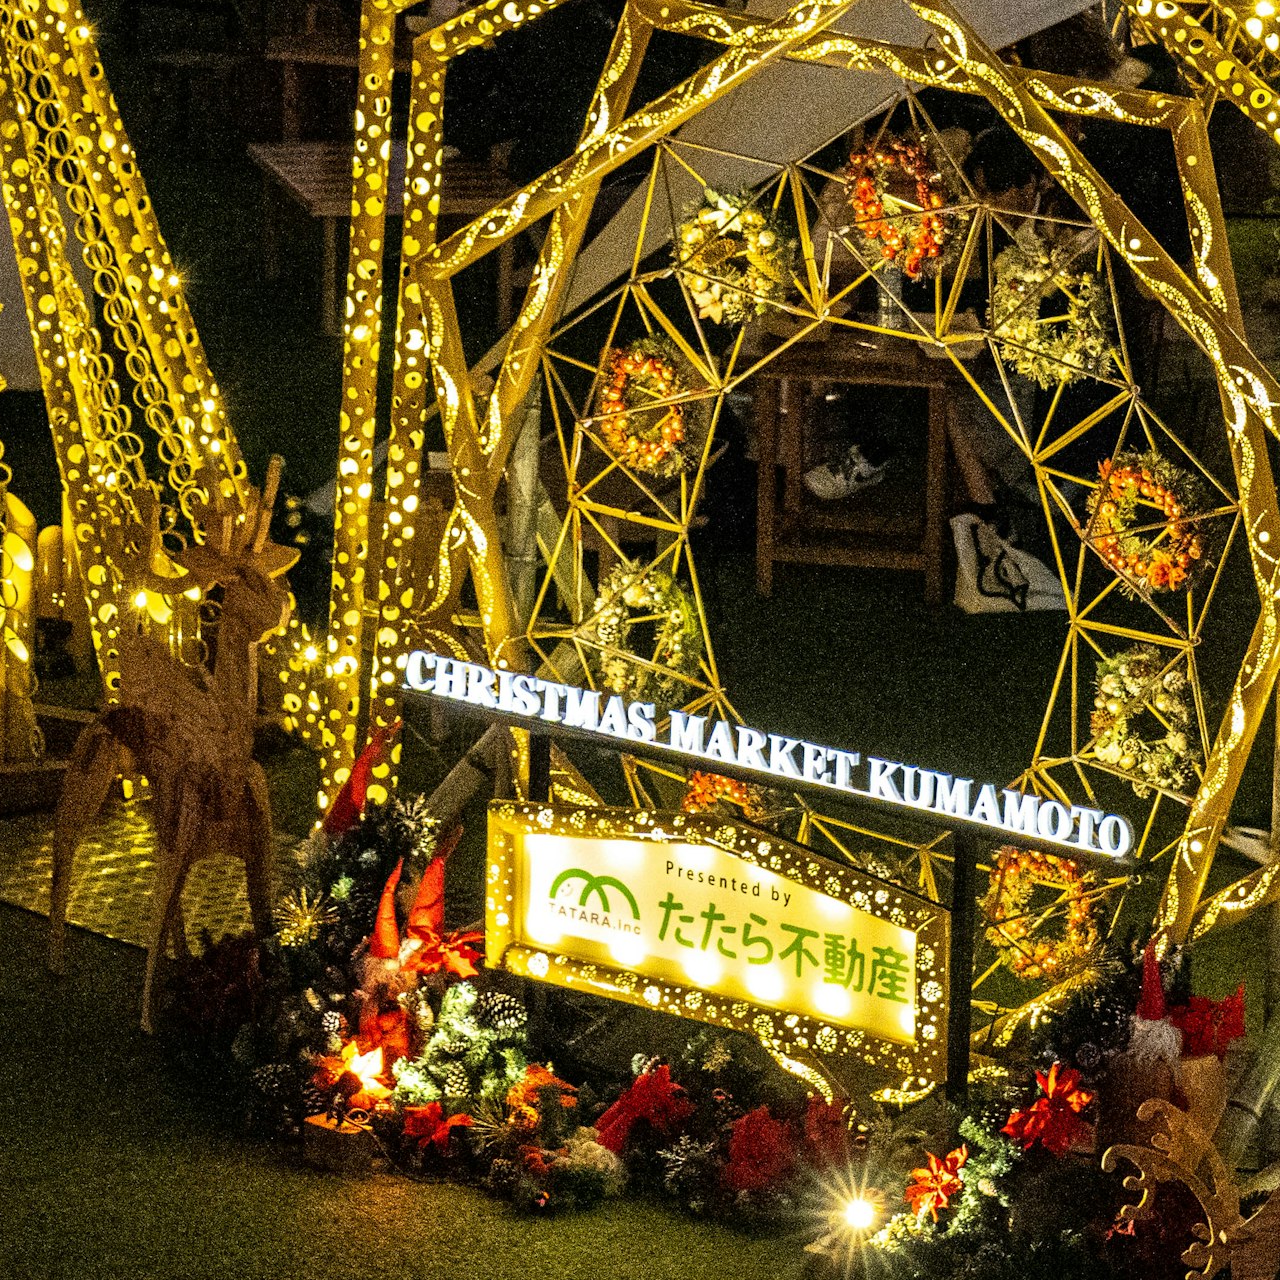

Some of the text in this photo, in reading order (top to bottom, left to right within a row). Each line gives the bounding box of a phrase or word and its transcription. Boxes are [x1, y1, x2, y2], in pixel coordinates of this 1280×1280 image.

[405, 650, 1133, 858] CHRISTMAS MARKET KUMAMOTO
[666, 860, 793, 908] Presented by
[658, 891, 911, 1006] たたら不動産
